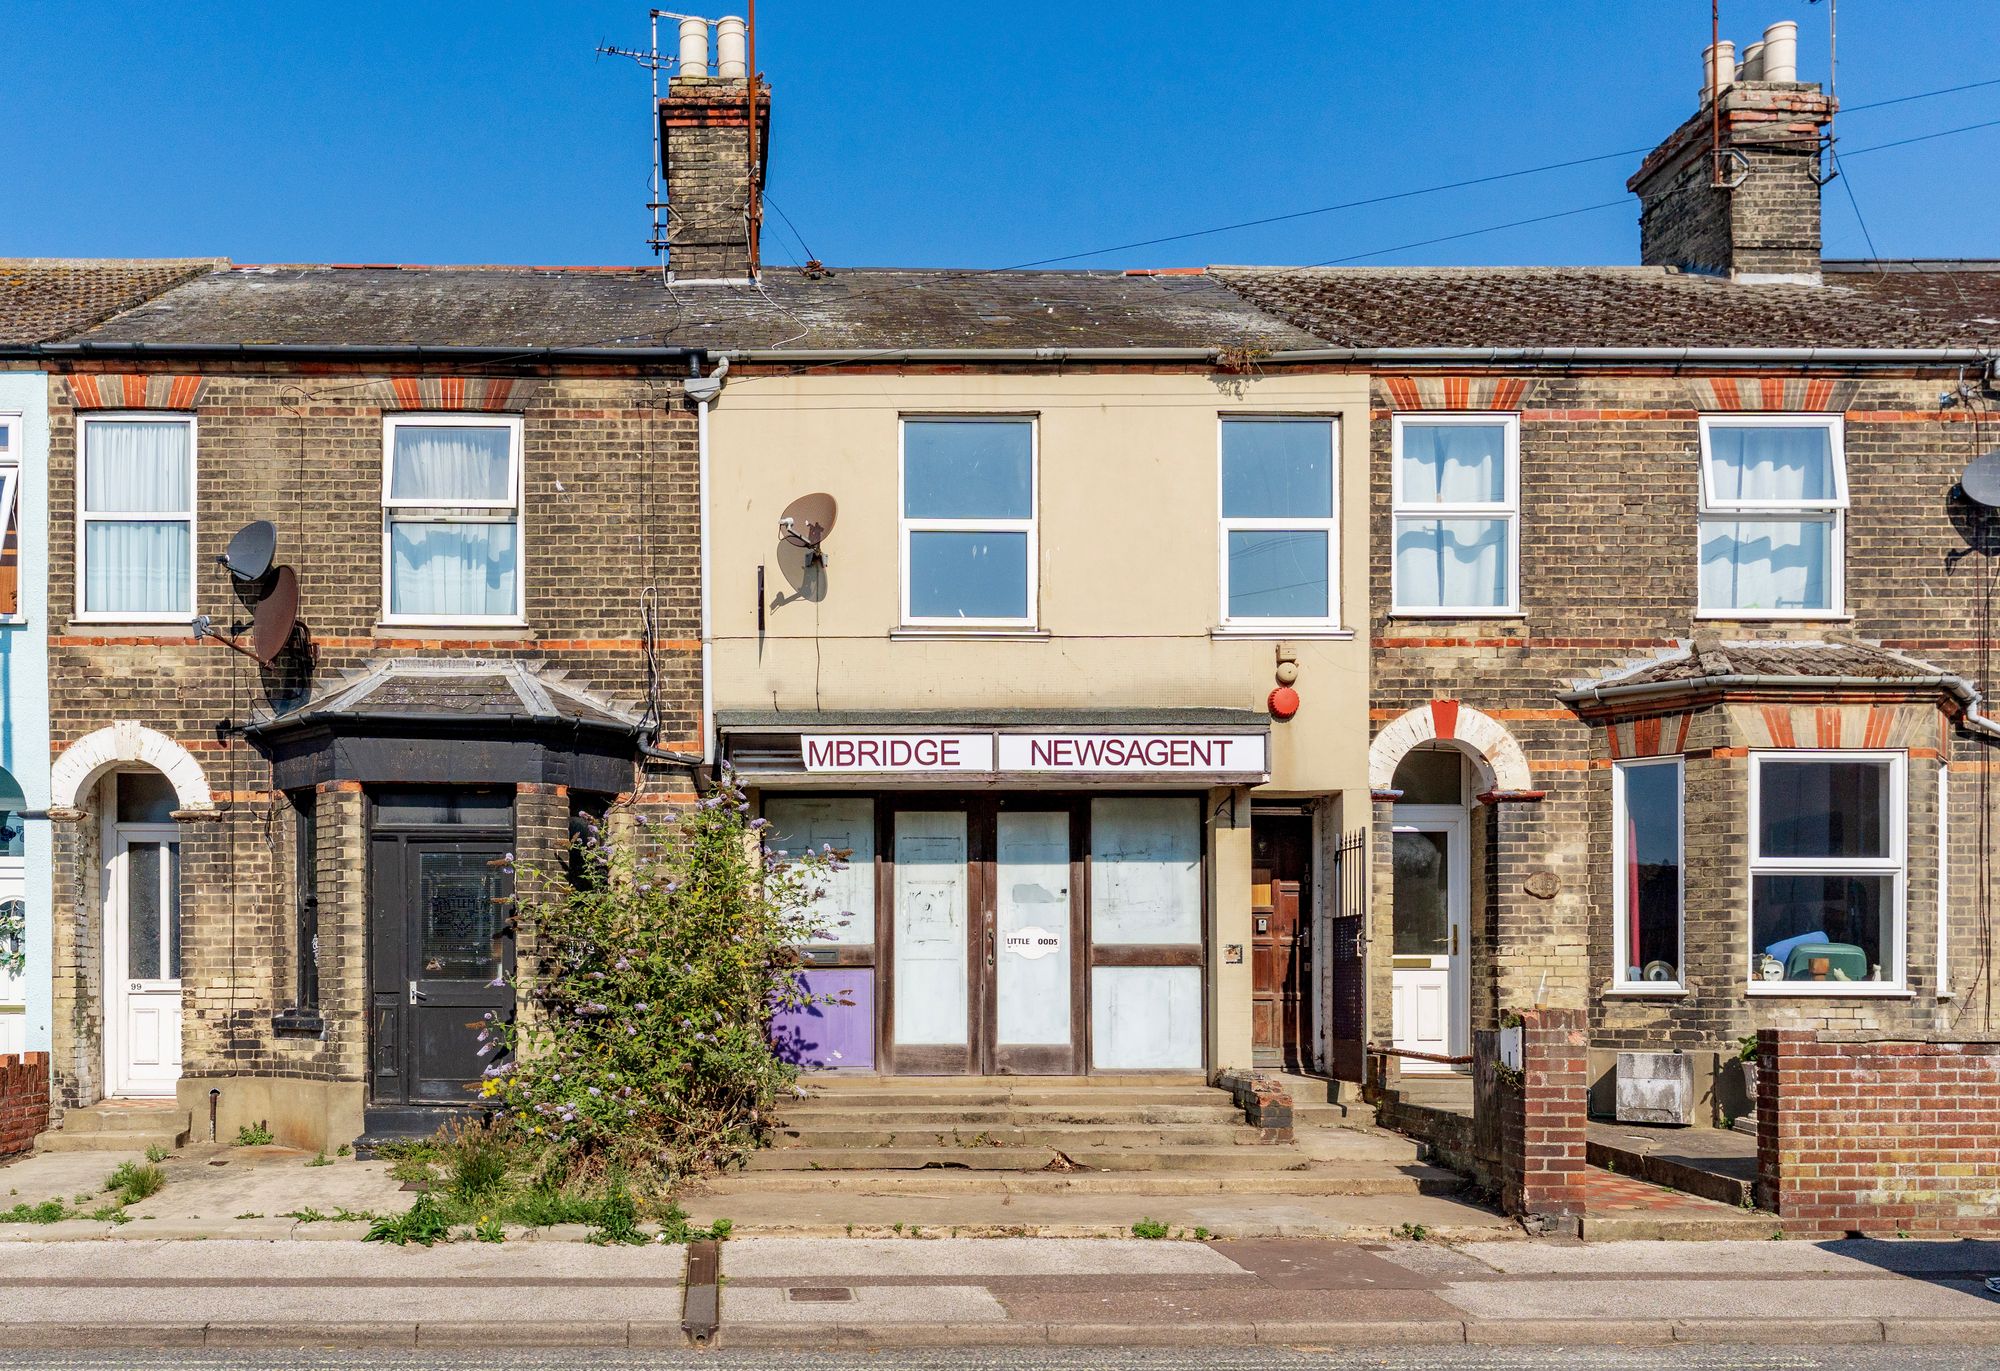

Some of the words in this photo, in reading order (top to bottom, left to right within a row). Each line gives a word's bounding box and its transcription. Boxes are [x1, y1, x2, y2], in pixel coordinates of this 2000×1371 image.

[808, 740, 960, 766] MBRIDGE
[1031, 740, 1233, 766] NEWSAGENT
[130, 983, 142, 991] 99
